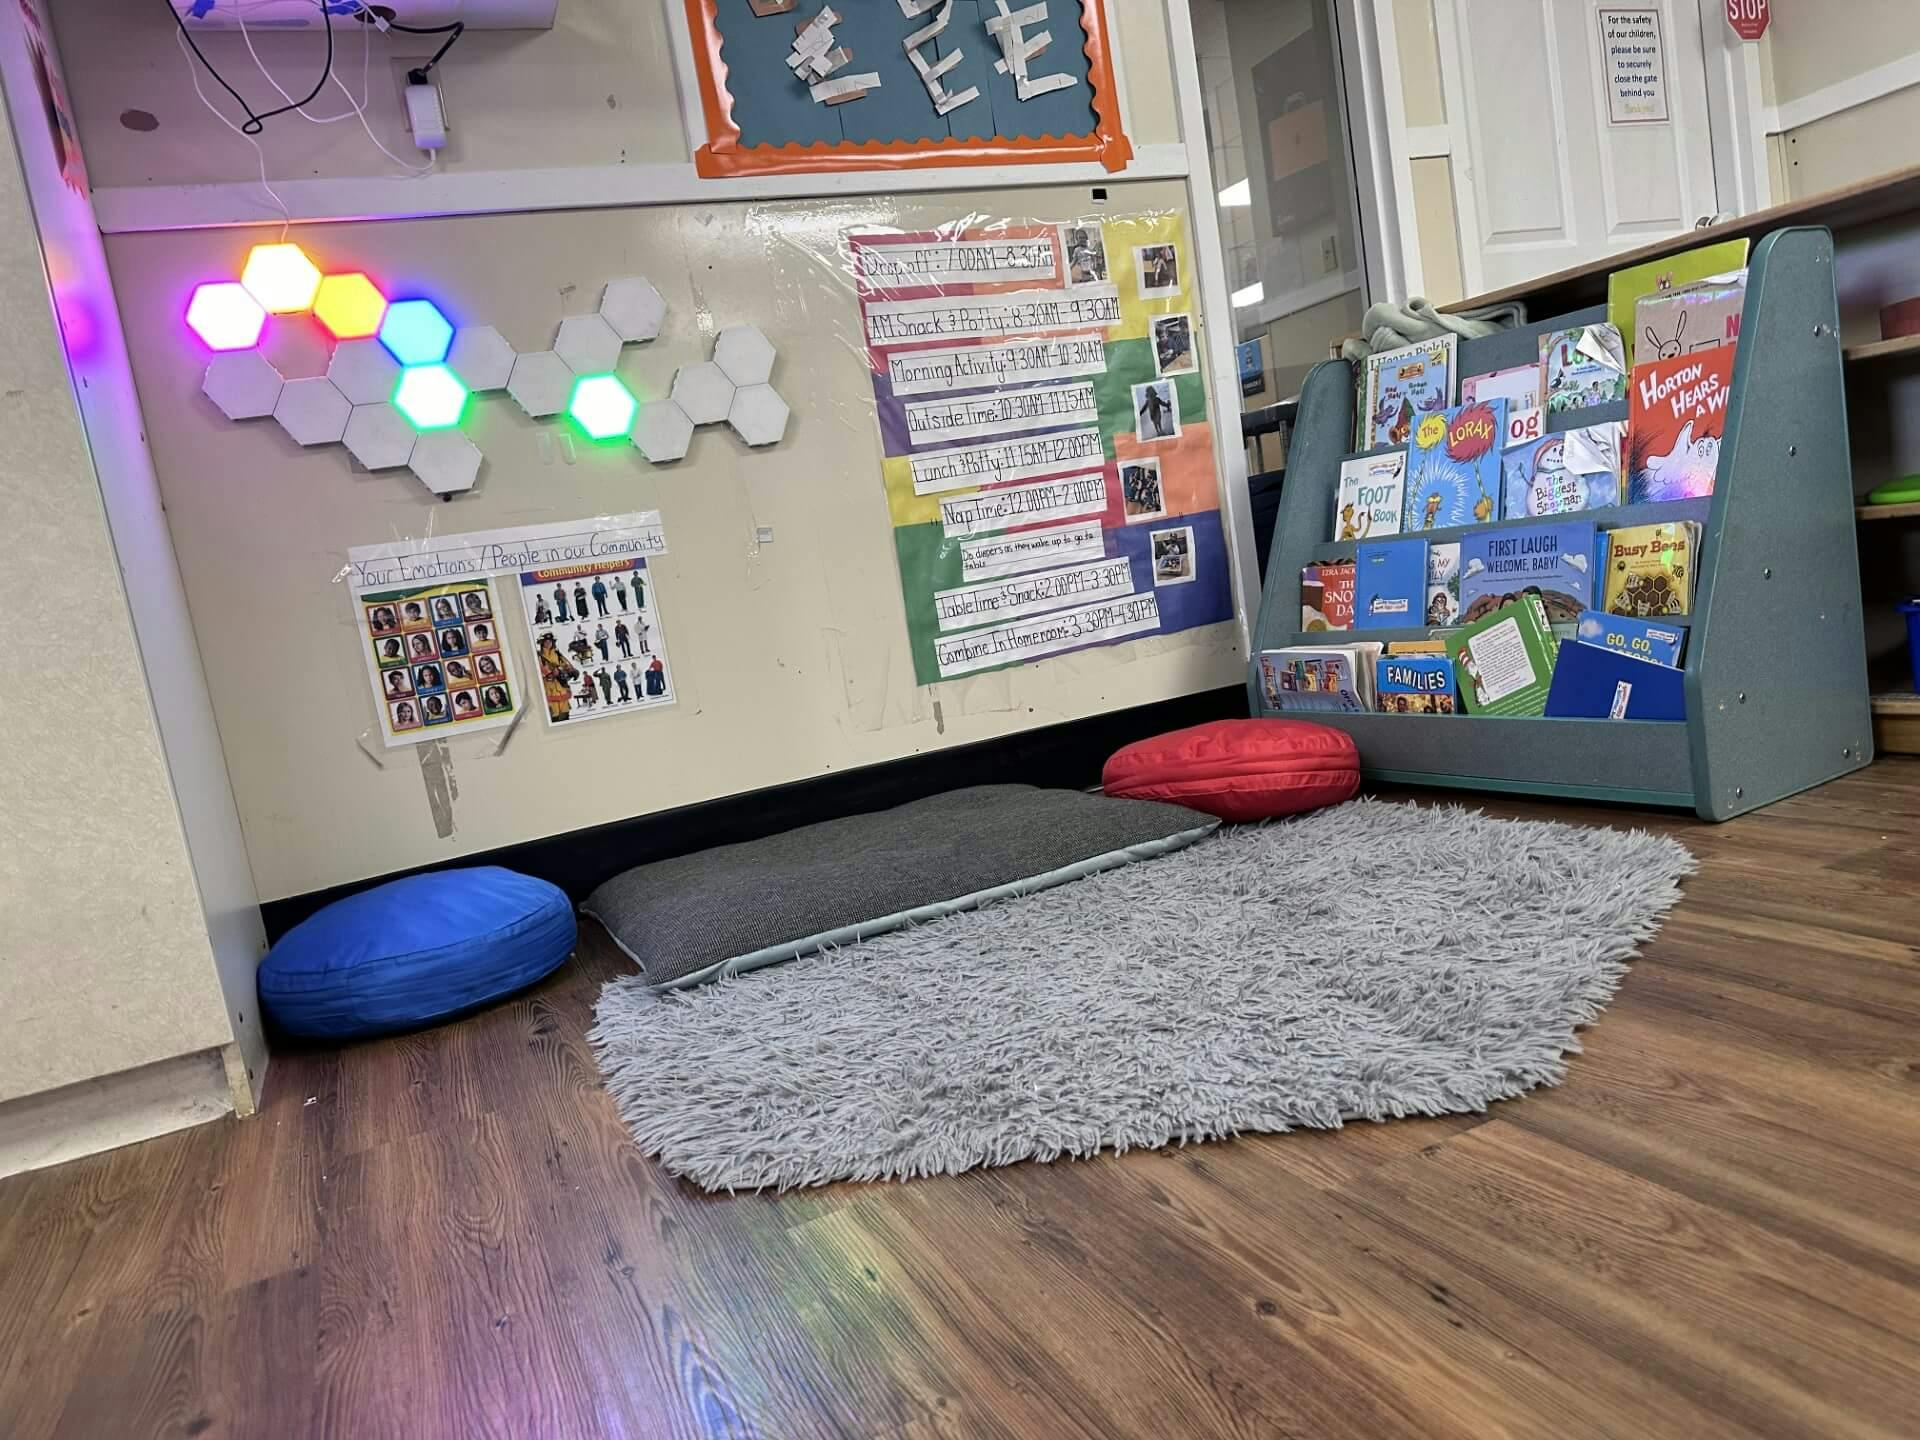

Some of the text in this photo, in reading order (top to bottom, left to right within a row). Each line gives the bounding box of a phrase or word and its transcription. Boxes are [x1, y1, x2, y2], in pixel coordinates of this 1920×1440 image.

[1607, 15, 1652, 25] For the safety
[1729, 0, 1767, 20] STOP
[1607, 29, 1615, 38] of
[1628, 30, 1656, 39] children,
[1611, 45, 1632, 56] please
[1633, 44, 1641, 54] be
[1626, 61, 1652, 70] securely
[1614, 74, 1658, 84] close the gate
[1619, 88, 1655, 99] behind you
[872, 314, 893, 339] AM
[896, 311, 944, 337] Snack
[960, 306, 1010, 337] Potty:
[891, 360, 953, 386] Morning
[955, 351, 1008, 383] Activity:
[1639, 363, 1703, 411] HORTON
[1670, 373, 1720, 419] HEARS
[908, 405, 964, 432] Outside
[1696, 403, 1707, 418] A
[1421, 425, 1440, 438] The
[1450, 418, 1494, 447] LORAX
[913, 455, 957, 482] Lunch
[965, 449, 1004, 481] Potty:
[1546, 474, 1564, 486] The
[1358, 484, 1396, 506] FOOT
[1536, 481, 1577, 501] Biggest
[944, 502, 971, 531] Nap
[975, 497, 1007, 521] Time:
[1373, 508, 1398, 523] BOOK
[962, 549, 974, 562] Do
[1014, 542, 1030, 551] they
[1031, 538, 1050, 549] wake
[1051, 536, 1062, 547] up
[1063, 534, 1071, 544] to
[1074, 535, 1084, 545] go
[1084, 531, 1094, 540] to
[1488, 535, 1558, 557] FIRST LAUGH
[1613, 540, 1686, 558] Busy Bees
[355, 560, 390, 586] Your
[398, 553, 475, 582] Emotions
[492, 543, 540, 572] People
[546, 548, 560, 562] in
[564, 547, 585, 560] our
[590, 532, 664, 557] Community
[1437, 558, 1450, 568] MY
[1487, 555, 1560, 573] WELCOME, BABY!
[1338, 580, 1354, 590] TH
[940, 591, 973, 618] Table
[1324, 590, 1355, 604] SNO
[1336, 603, 1355, 617] DA
[938, 639, 989, 665] Combine
[1606, 632, 1627, 649] GO,
[1631, 637, 1653, 656] GO,
[1386, 665, 1447, 690] FAMILIES
